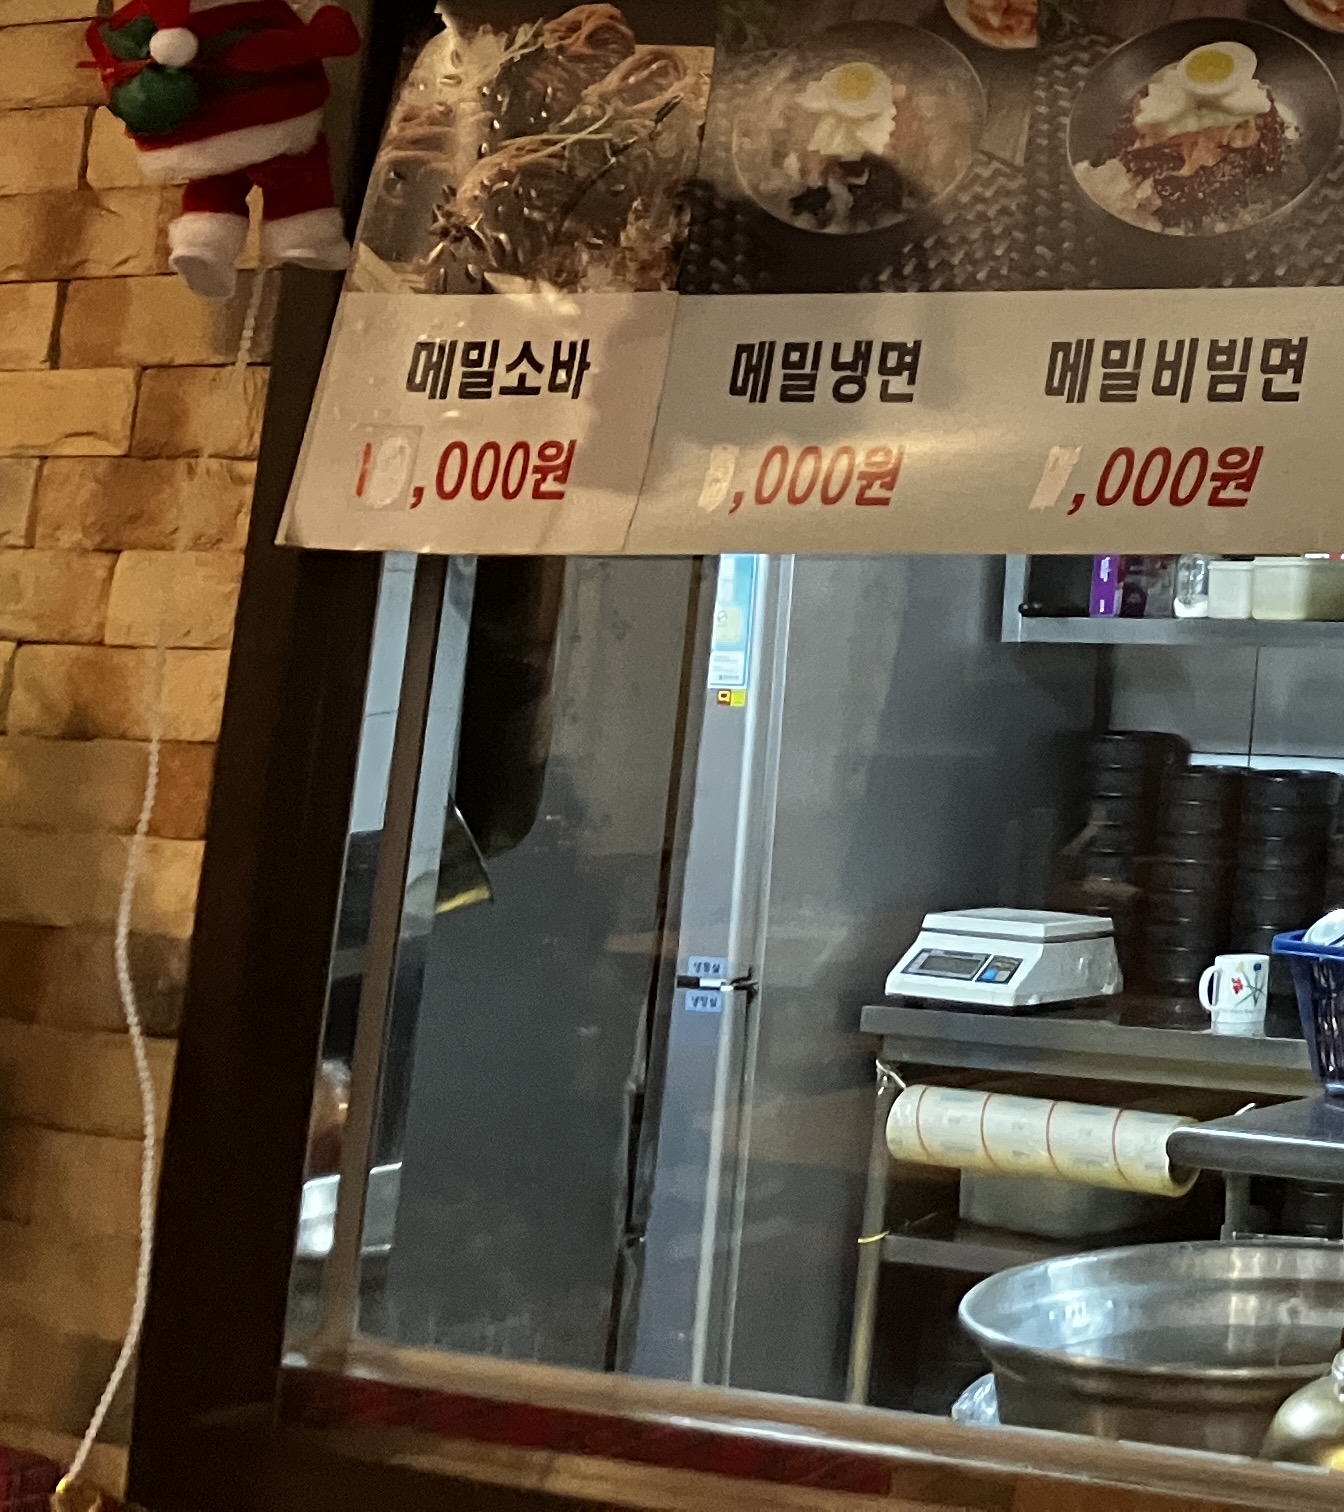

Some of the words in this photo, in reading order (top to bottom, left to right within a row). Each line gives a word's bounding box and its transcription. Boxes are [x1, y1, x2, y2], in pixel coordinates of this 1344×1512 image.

[405, 338, 592, 401] 메밀소바
[728, 338, 922, 404] 메밀냉면
[1043, 335, 1309, 404] 메밀비빔면
[354, 438, 577, 510] 1,000원
